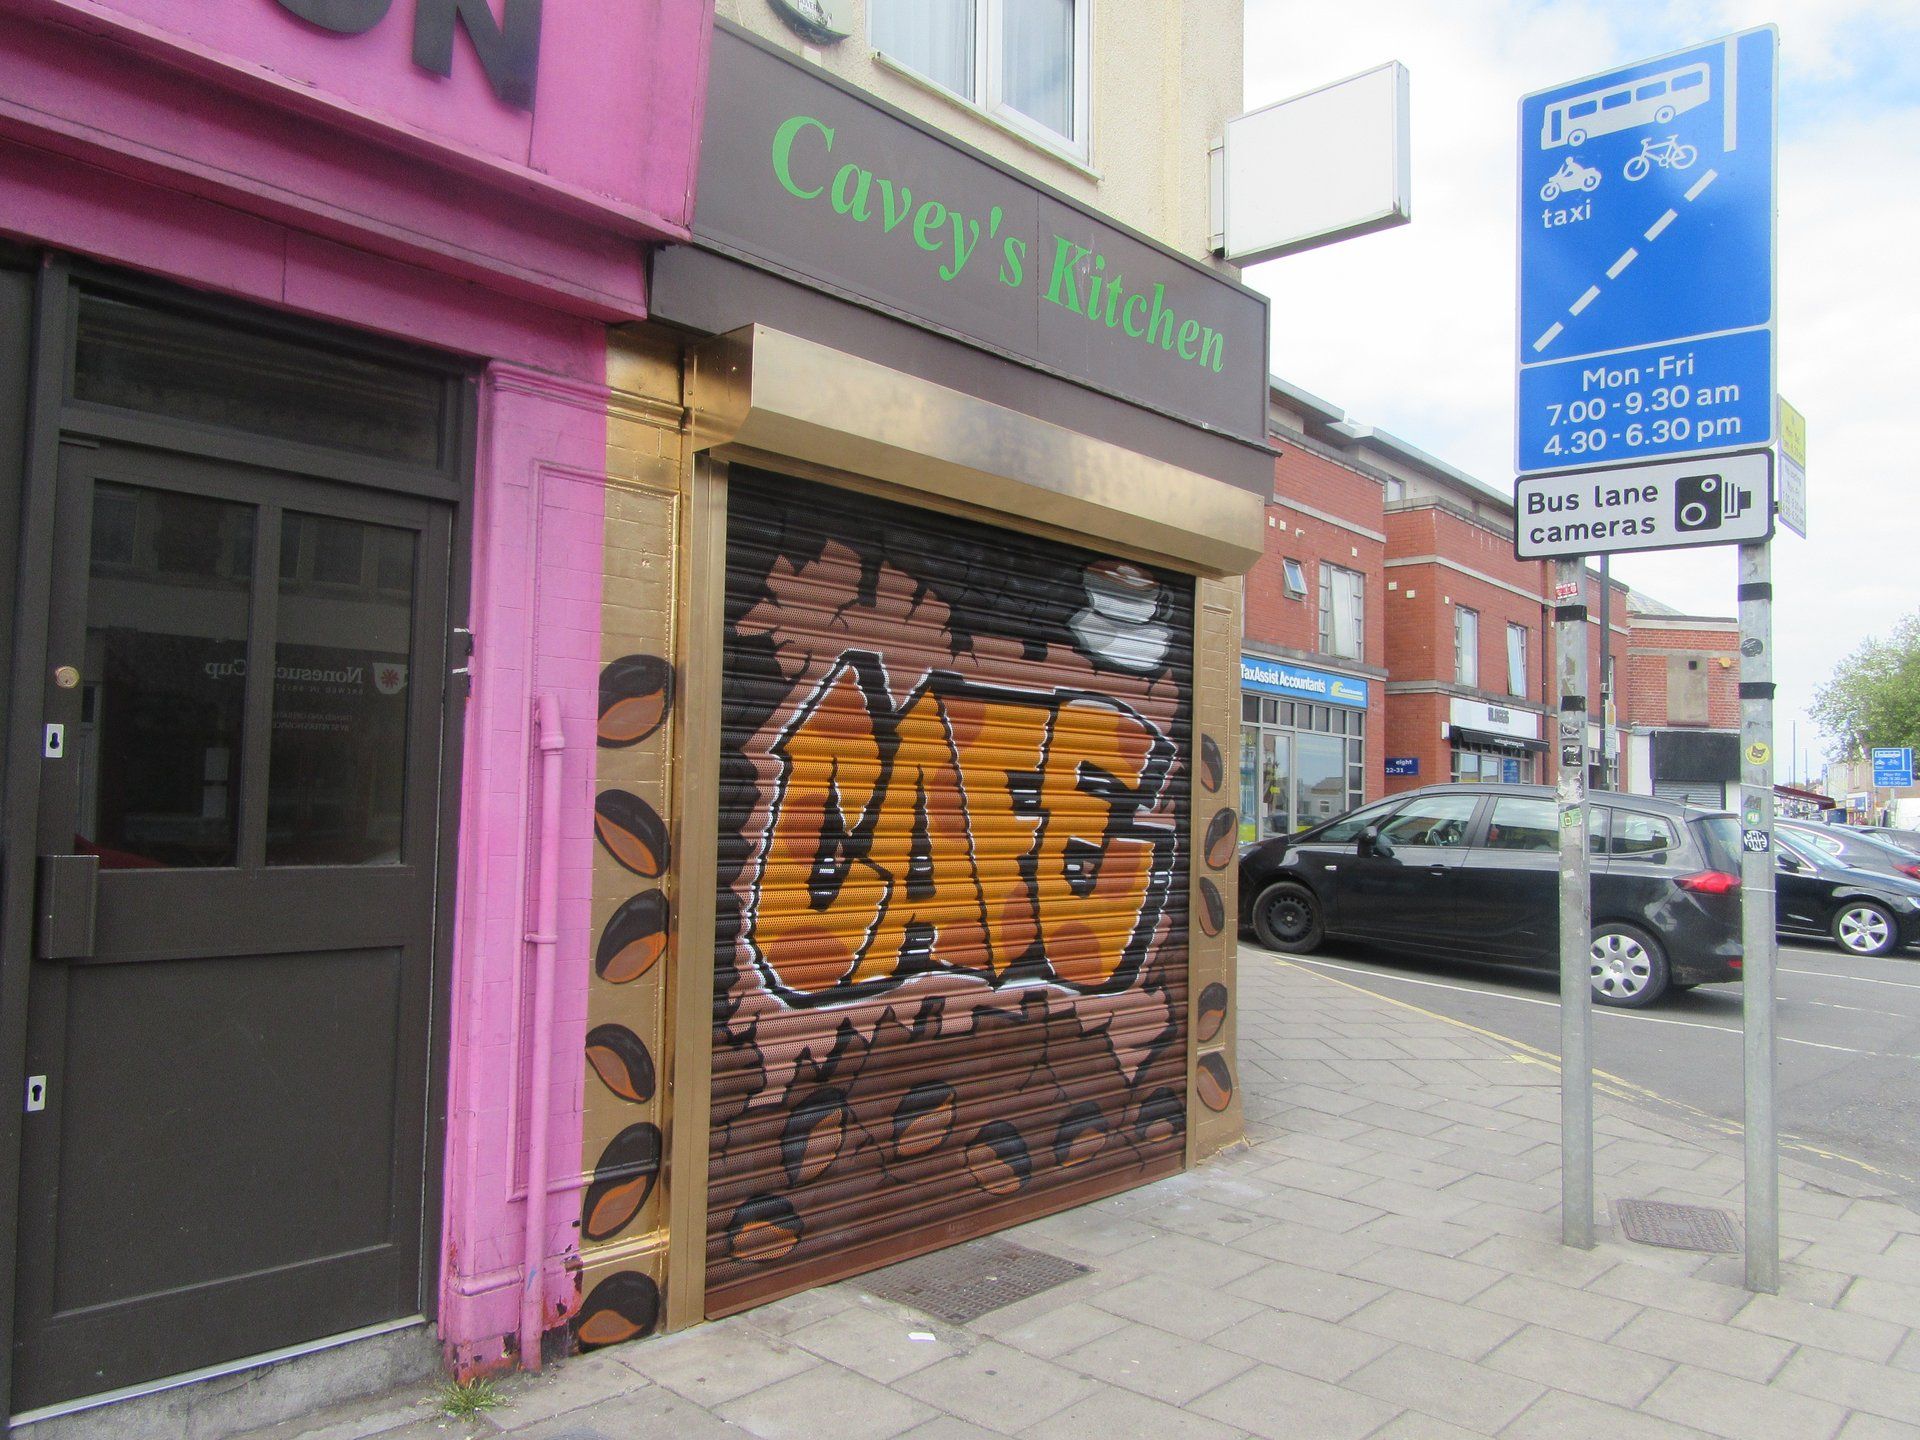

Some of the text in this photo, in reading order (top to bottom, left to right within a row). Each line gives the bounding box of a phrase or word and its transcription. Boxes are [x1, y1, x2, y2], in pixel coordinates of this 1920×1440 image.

[266, 0, 545, 114] N
[1542, 198, 1592, 229] taxi
[771, 115, 1225, 374] Cavey's Kitchen
[1696, 384, 1740, 406] am
[1697, 416, 1742, 442] pm
[1527, 484, 1659, 515] Bus lane
[1529, 516, 1656, 544] cameras
[1240, 663, 1279, 686] TaxAssist
[1280, 671, 1326, 694] Accountants
[749, 649, 1178, 1011] CAFE
